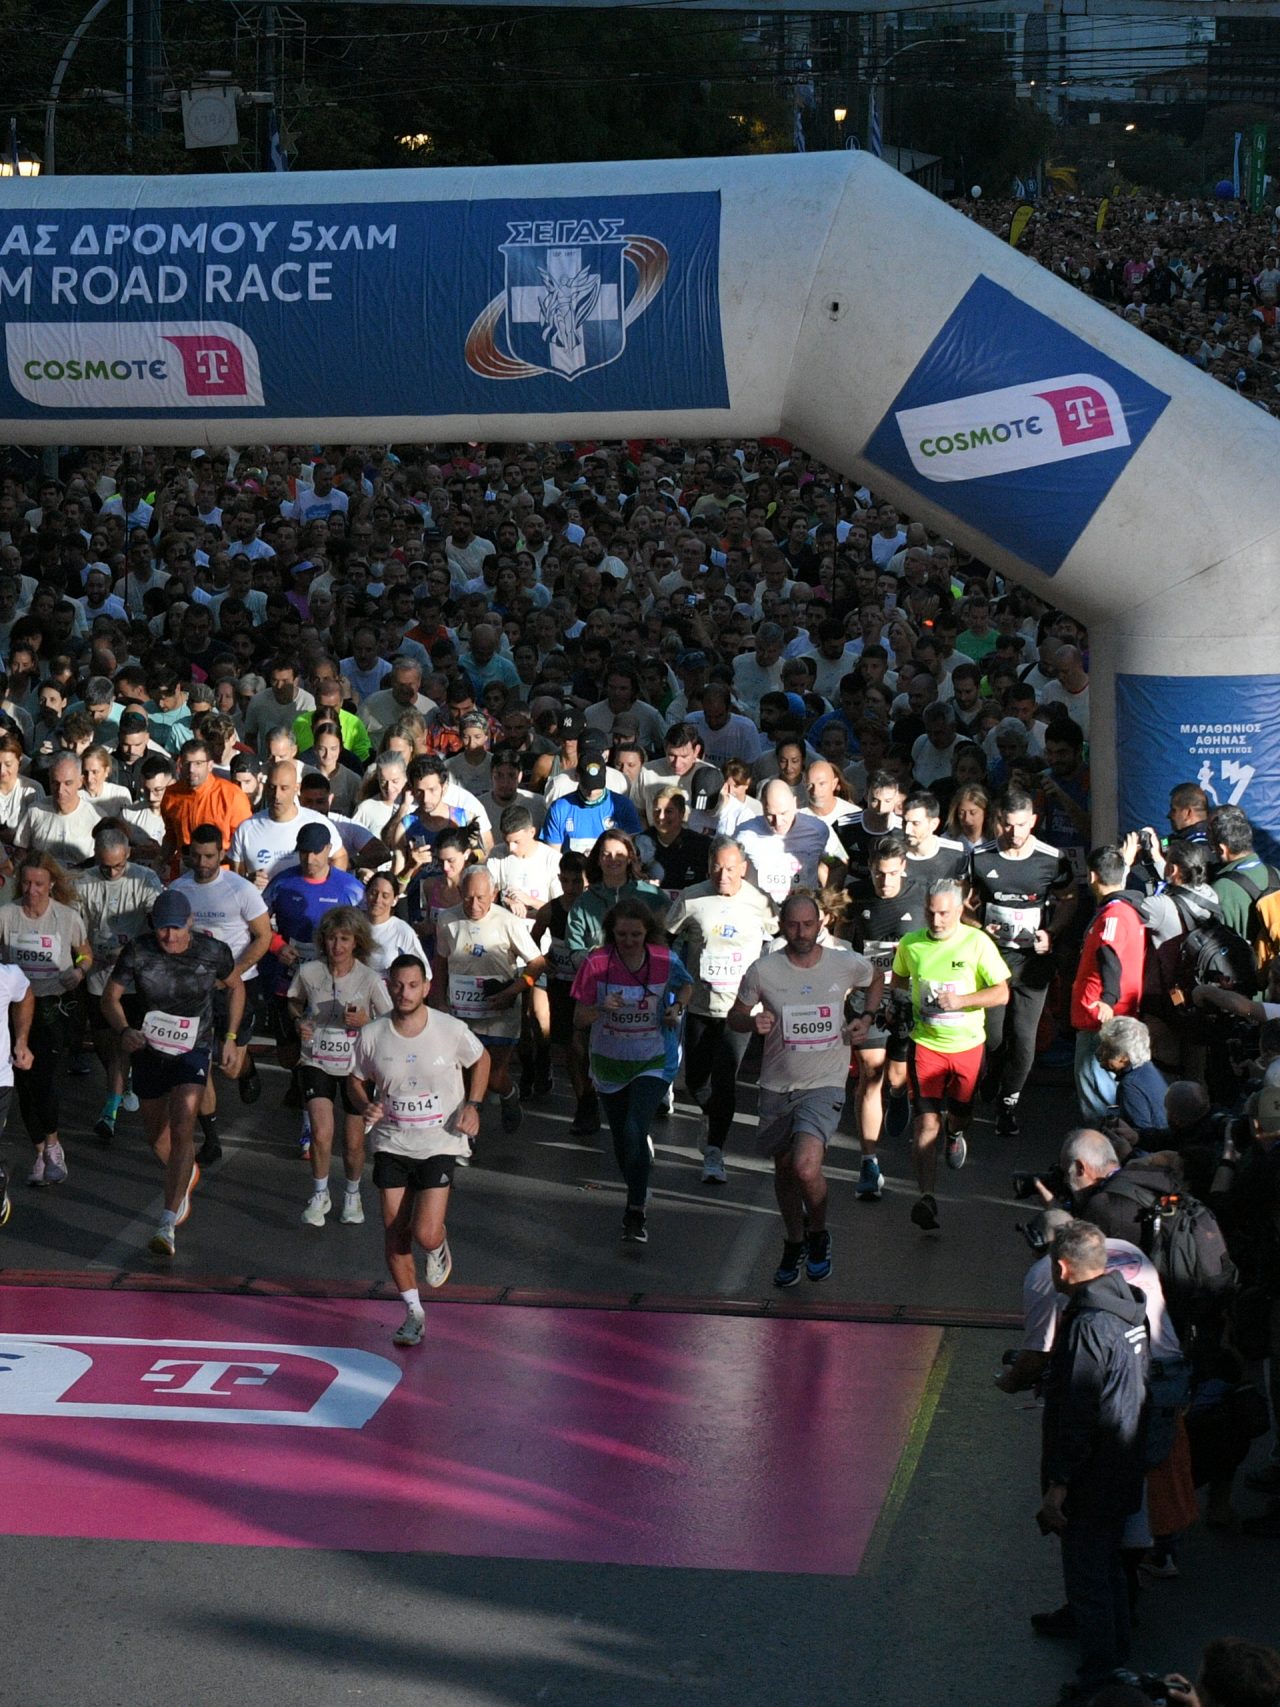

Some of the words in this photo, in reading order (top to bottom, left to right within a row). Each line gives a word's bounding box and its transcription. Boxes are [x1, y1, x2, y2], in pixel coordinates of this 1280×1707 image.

[70, 221, 279, 255] ΔΡΟΜΟΥ
[505, 219, 624, 245] ΣΕΓΑΣ
[51, 264, 189, 305] ROAD
[205, 261, 334, 303] RACE
[23, 359, 168, 381] COSMOTE
[919, 416, 1044, 458] COSMOTE
[1180, 723, 1262, 734] ΜΑΡΑΘΩΝΙΟΣ
[1195, 735, 1247, 745] ΑΘΗΝΑΣ
[1197, 746, 1253, 755] ΑΥΘΕΝΤΙΚΟΣ
[767, 873, 801, 884] 5633
[16, 950, 53, 962] 56952
[611, 1011, 650, 1024] 56955
[150, 1025, 189, 1041] 76109
[792, 1021, 833, 1034] 56099
[392, 1099, 433, 1112] 57614
